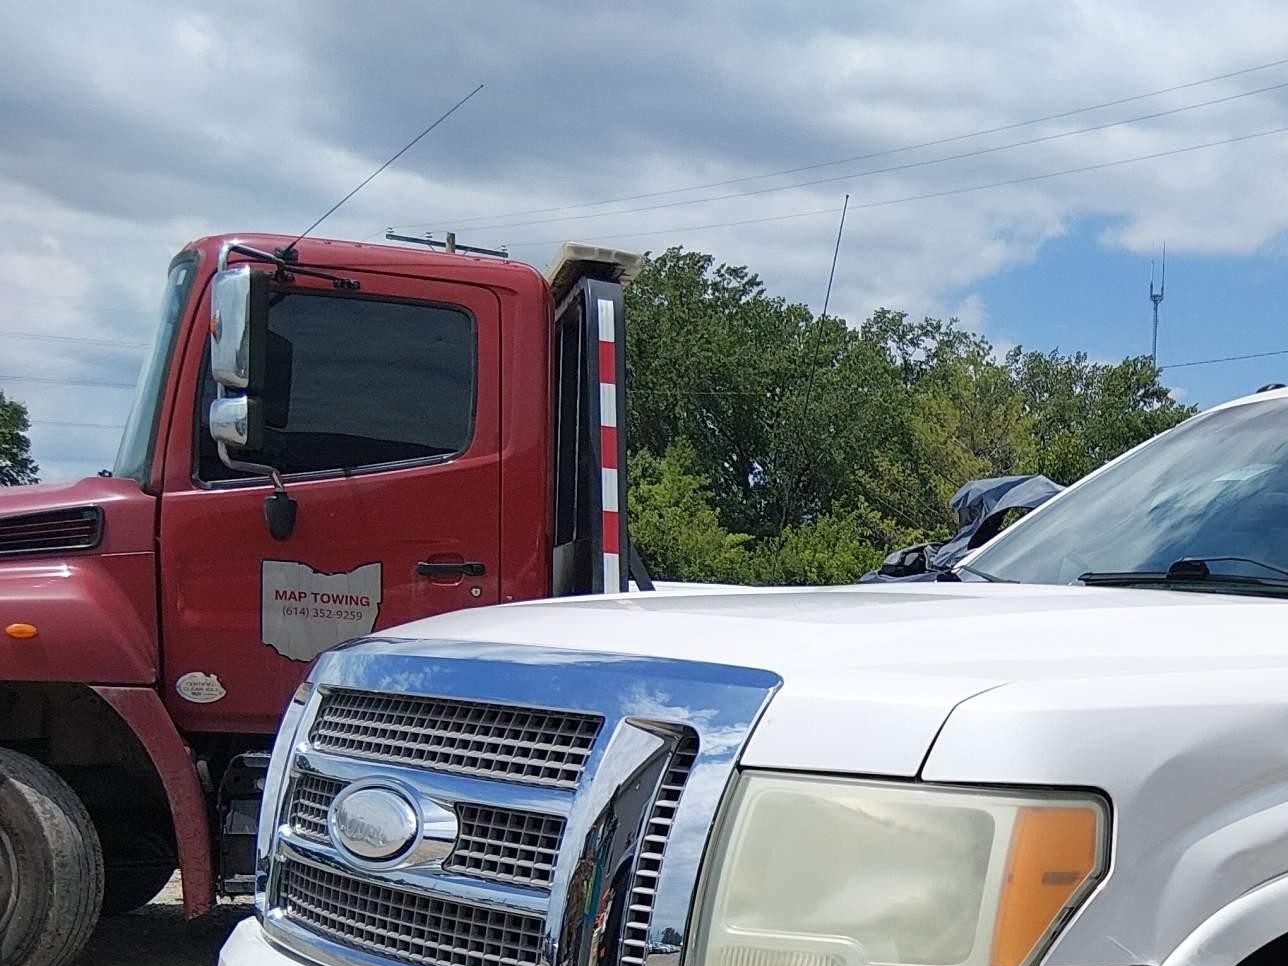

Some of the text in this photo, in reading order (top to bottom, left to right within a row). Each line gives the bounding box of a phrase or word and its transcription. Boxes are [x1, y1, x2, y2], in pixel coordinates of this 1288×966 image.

[275, 590, 370, 607] MAP TOWING
[282, 607, 363, 620] (614) 352-9259
